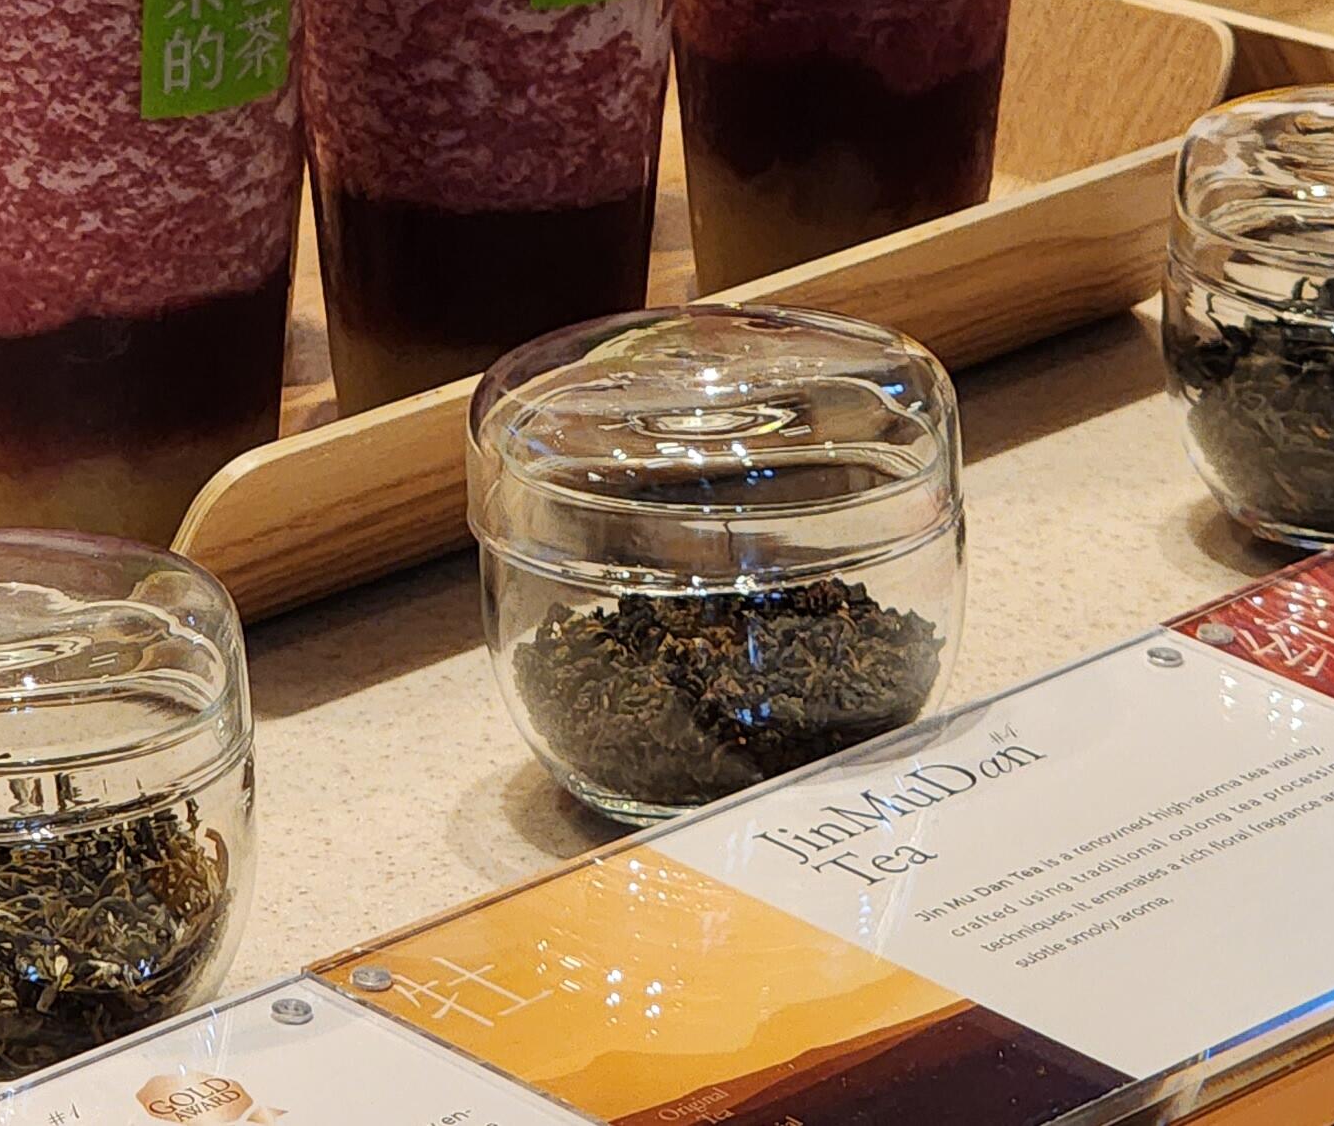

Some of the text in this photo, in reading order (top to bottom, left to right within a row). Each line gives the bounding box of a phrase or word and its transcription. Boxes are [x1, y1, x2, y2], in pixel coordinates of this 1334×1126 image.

[163, 8, 283, 95] 的茶
[752, 743, 1047, 865] JinMuDan
[811, 844, 938, 886] Tea
[914, 907, 948, 922] Jin
[943, 894, 978, 911] Mu
[972, 879, 1014, 898] Dan
[1007, 866, 1045, 881] Tea
[1039, 858, 1061, 869] is
[1059, 852, 1074, 861] a
[1072, 816, 1154, 856] renowned
[1147, 779, 1243, 821] high-aroma
[1239, 768, 1270, 782] tea
[951, 903, 1019, 937] crafted
[1018, 881, 1074, 907] using
[1070, 838, 1169, 883] traditional
[1168, 812, 1233, 842] oolong
[1228, 799, 1262, 814] tea
[1071, 902, 1093, 912] It
[1090, 868, 1169, 905] emanates
[1166, 863, 1182, 871] a
[1179, 848, 1214, 865] rich
[1208, 829, 1253, 851] floral
[1247, 800, 1322, 833] fragrance
[1015, 943, 1067, 968] subtle
[1065, 918, 1120, 946] smoky
[148, 1077, 231, 1116] GOLD
[174, 1089, 242, 1123] AWARD
[658, 1087, 730, 1121] Original
